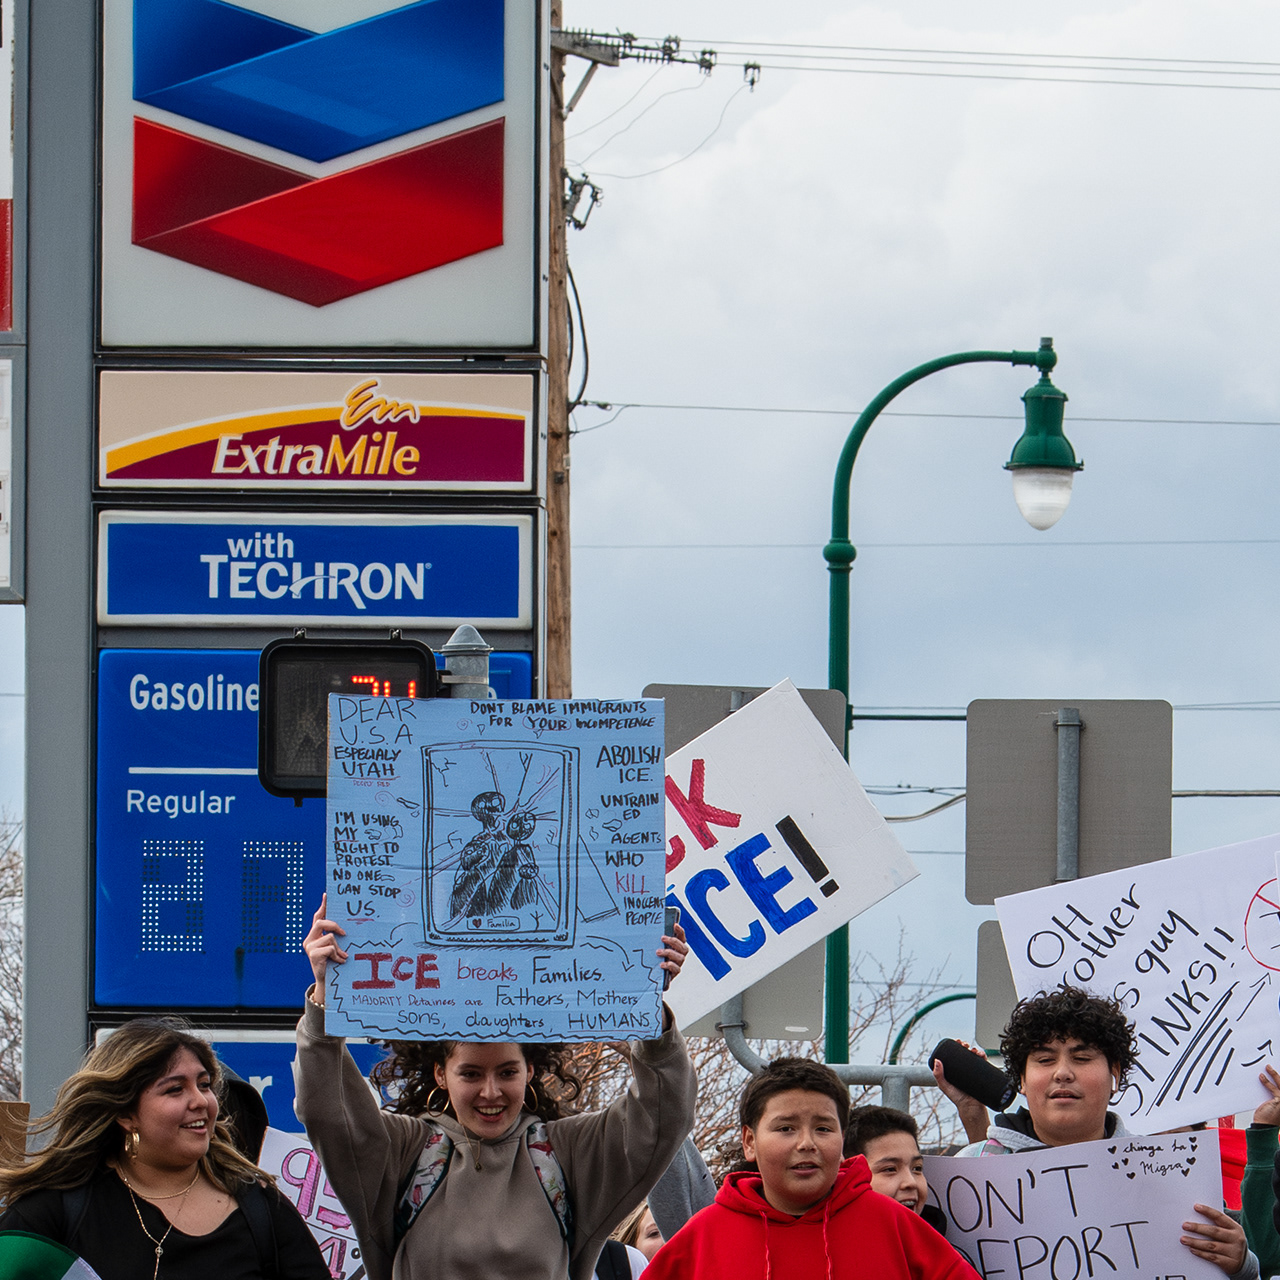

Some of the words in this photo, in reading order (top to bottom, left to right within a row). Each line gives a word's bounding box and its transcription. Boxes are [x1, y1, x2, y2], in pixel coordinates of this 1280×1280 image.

[211, 431, 420, 476] ExtraMile
[226, 531, 294, 558] with
[129, 674, 259, 712] Gasoline
[338, 697, 417, 722] DEAR
[512, 702, 557, 715] BLAME
[563, 701, 647, 715] IMMIGRANTS
[489, 716, 512, 727] FOR
[527, 716, 567, 730] YOUR
[596, 745, 661, 768] ABOLISH
[342, 761, 395, 778] UTAH
[619, 768, 654, 784] ICE.
[127, 789, 235, 819] Regular
[600, 792, 659, 808] UNTRAIN
[335, 811, 356, 825] I'M
[361, 813, 400, 827] USING
[623, 809, 641, 820] ED
[334, 827, 358, 841] MY
[334, 841, 380, 854] RIGHT
[383, 841, 400, 853] TO
[605, 850, 644, 868] WHO
[333, 869, 351, 882] NO
[357, 869, 382, 881] ONE
[615, 871, 650, 895] KILL
[337, 884, 361, 896] CAN
[370, 885, 401, 899] STOP
[1027, 903, 1094, 968] OH
[352, 952, 441, 990] ICE
[457, 957, 518, 982] breaks
[532, 956, 606, 985] Families.
[352, 994, 402, 1006] MAJORITY
[577, 988, 638, 1007] Mothers
[1139, 1160, 1184, 1176] Migra
